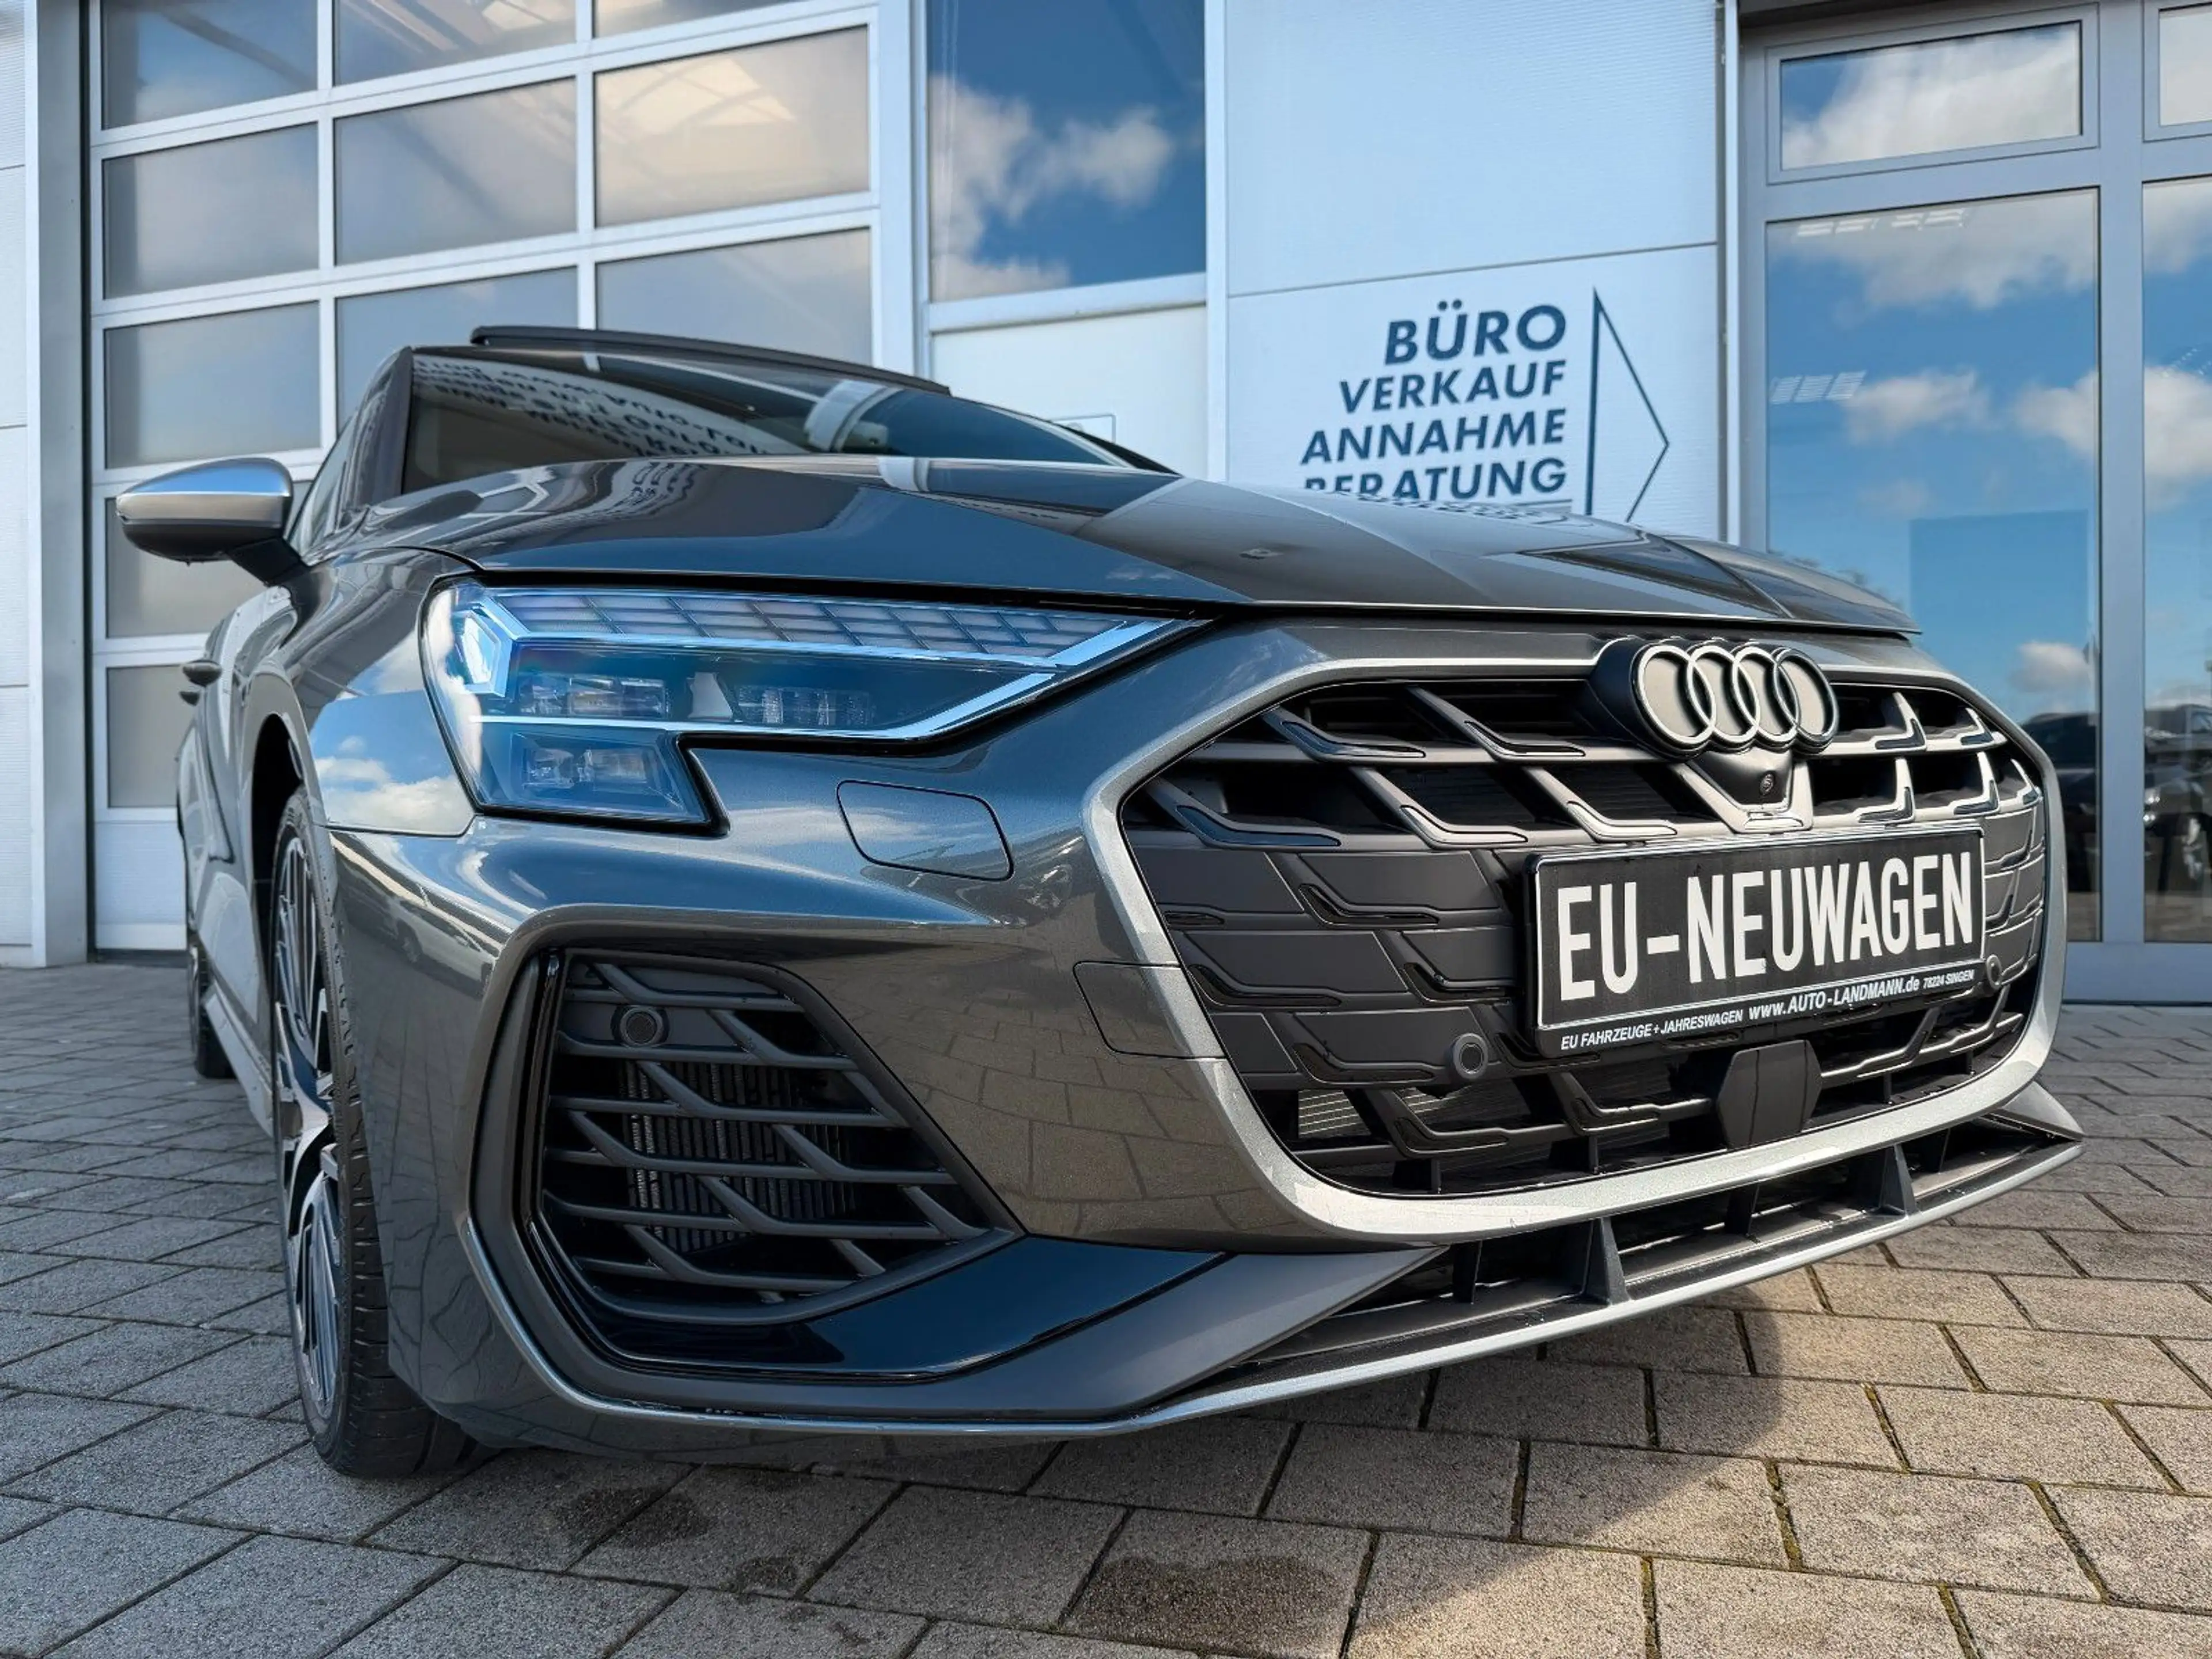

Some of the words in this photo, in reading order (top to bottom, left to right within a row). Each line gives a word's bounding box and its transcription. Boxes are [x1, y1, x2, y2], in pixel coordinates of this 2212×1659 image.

[1385, 299, 1567, 365] BÜRO
[1339, 360, 1567, 414] VERKAUF
[1300, 408, 1567, 465] ANNAHME
[1558, 851, 1973, 1001] EU-NEUWAGEN
[1561, 1035, 1578, 1050] EU
[1945, 969, 1975, 985] SINGEN
